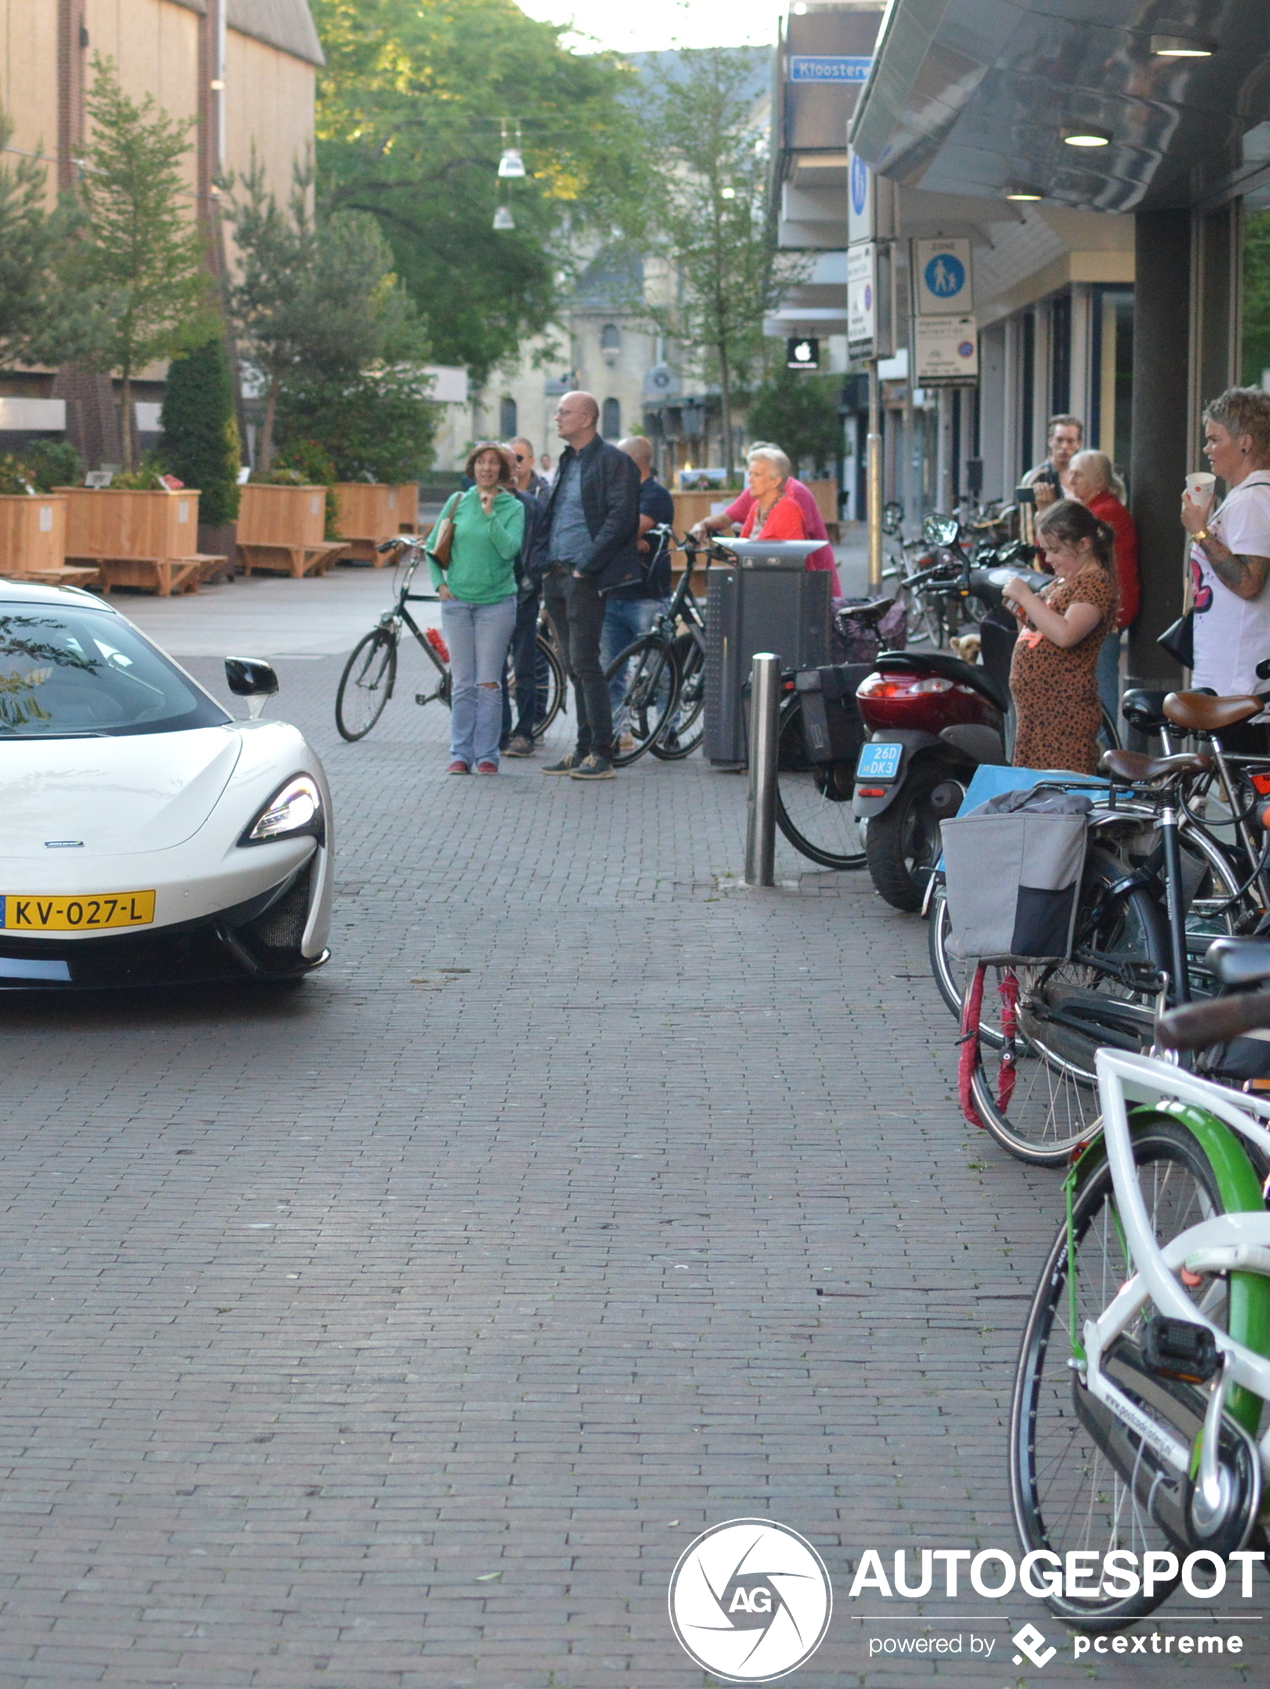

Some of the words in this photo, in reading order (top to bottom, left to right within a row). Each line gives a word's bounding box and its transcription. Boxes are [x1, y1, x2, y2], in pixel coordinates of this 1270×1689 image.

[873, 747, 897, 760] 26D
[870, 761, 894, 774] DK3
[16, 898, 143, 925] KV-027-L
